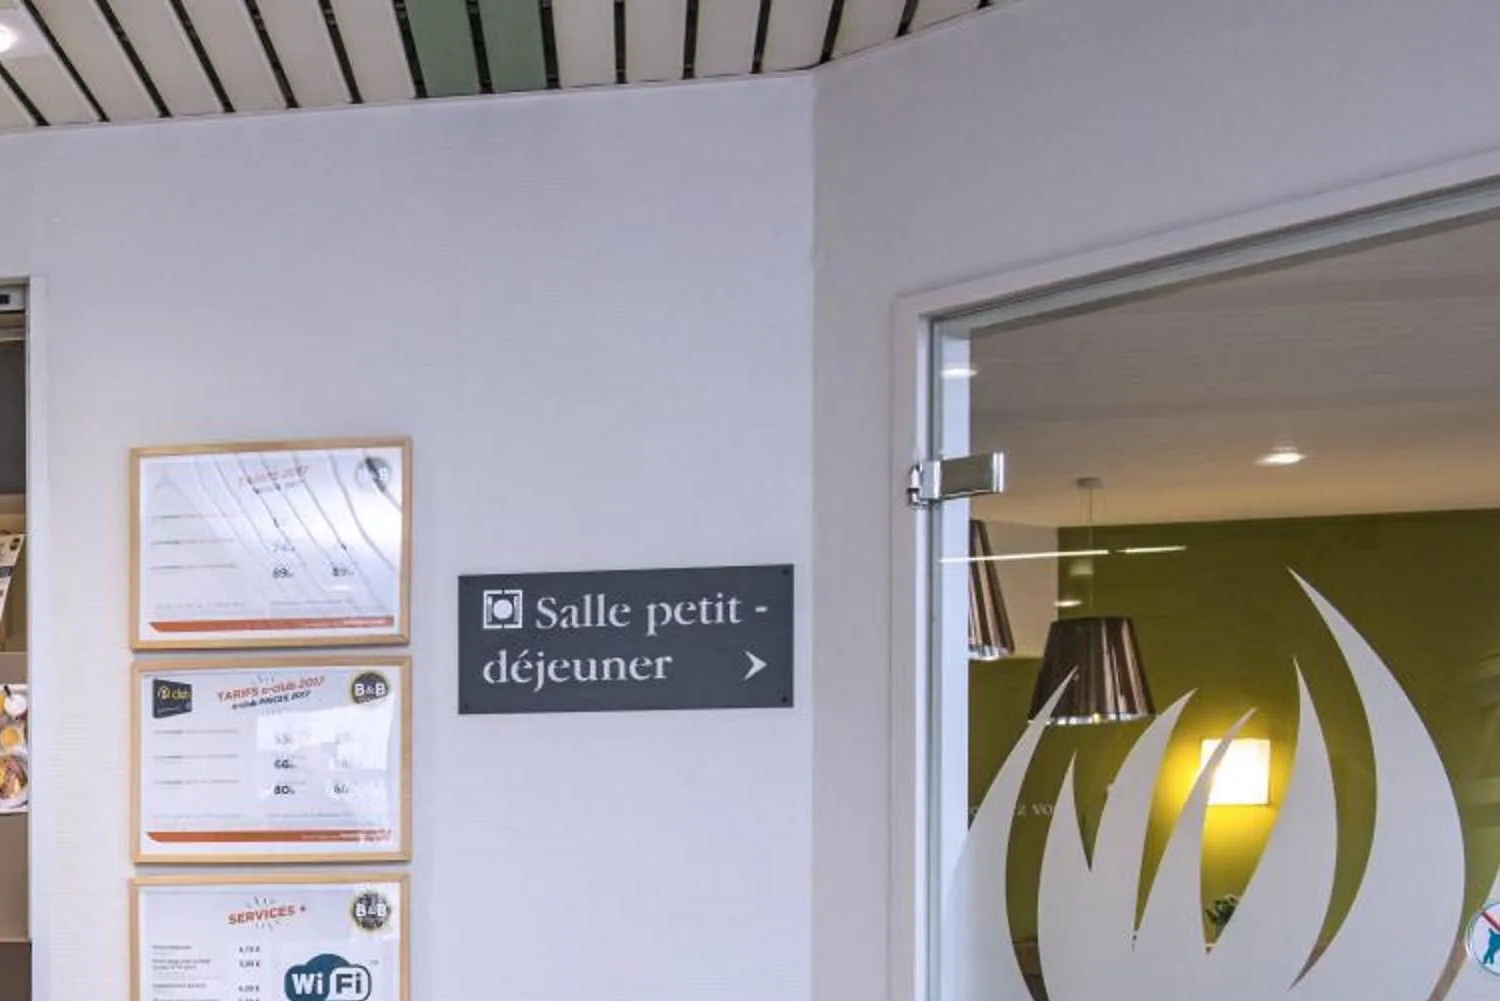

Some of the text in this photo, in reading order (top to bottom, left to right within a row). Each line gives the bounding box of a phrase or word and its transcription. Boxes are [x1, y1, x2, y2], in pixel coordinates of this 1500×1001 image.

[535, 593, 632, 629] Salle
[646, 591, 743, 637] petit
[482, 649, 673, 693] déjeuner
[227, 905, 297, 926] SERVICES
